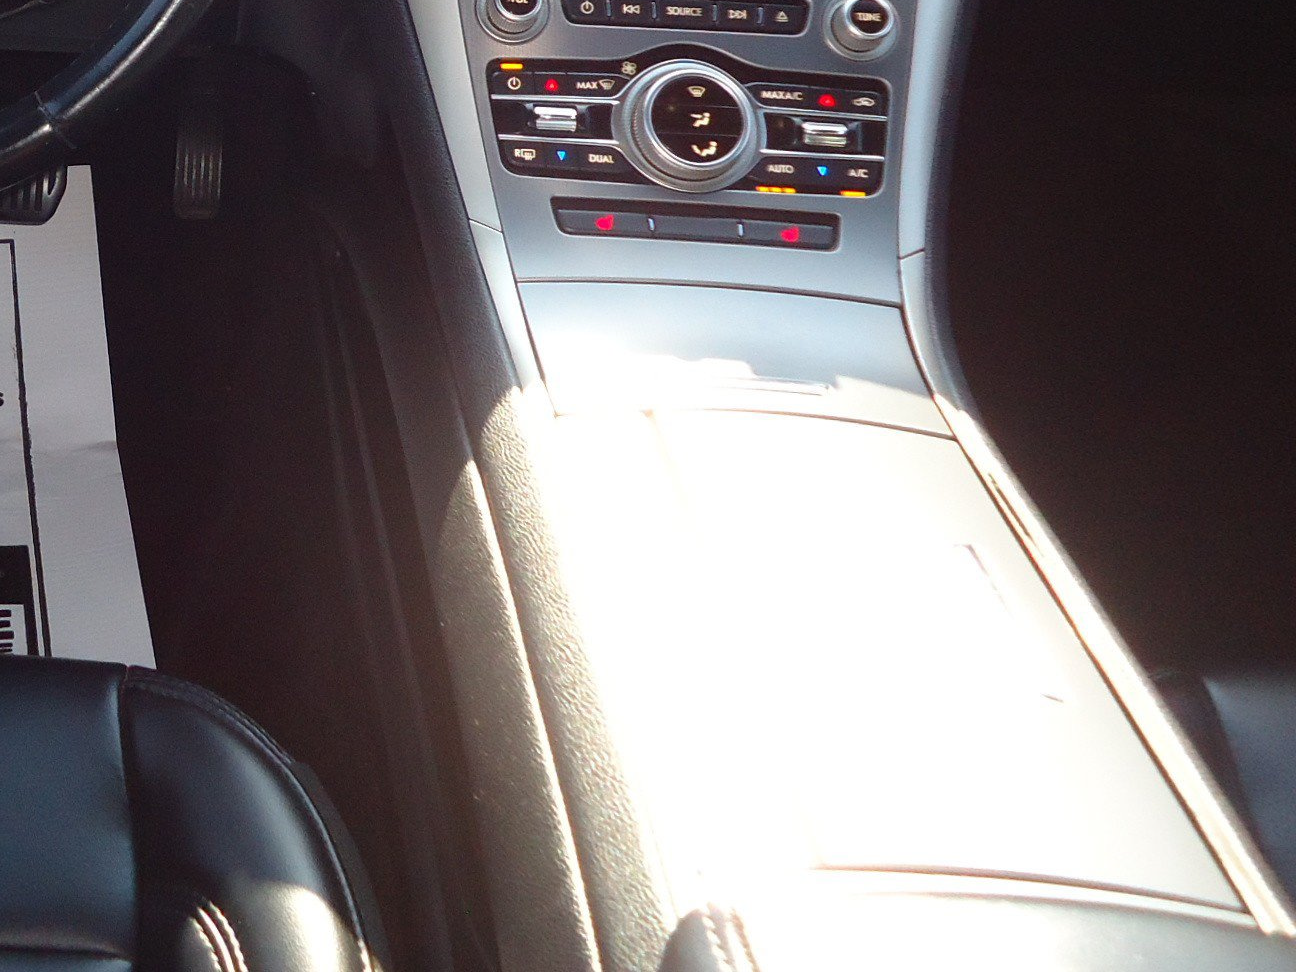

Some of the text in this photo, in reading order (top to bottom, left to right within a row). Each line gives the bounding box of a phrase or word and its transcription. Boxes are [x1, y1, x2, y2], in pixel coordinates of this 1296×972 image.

[666, 6, 703, 17] SOURCE
[856, 13, 882, 22] TUNE
[576, 81, 598, 89] MAX
[588, 154, 614, 163] DUAL
[768, 164, 794, 174] AUTO
[848, 168, 868, 178] A/C
